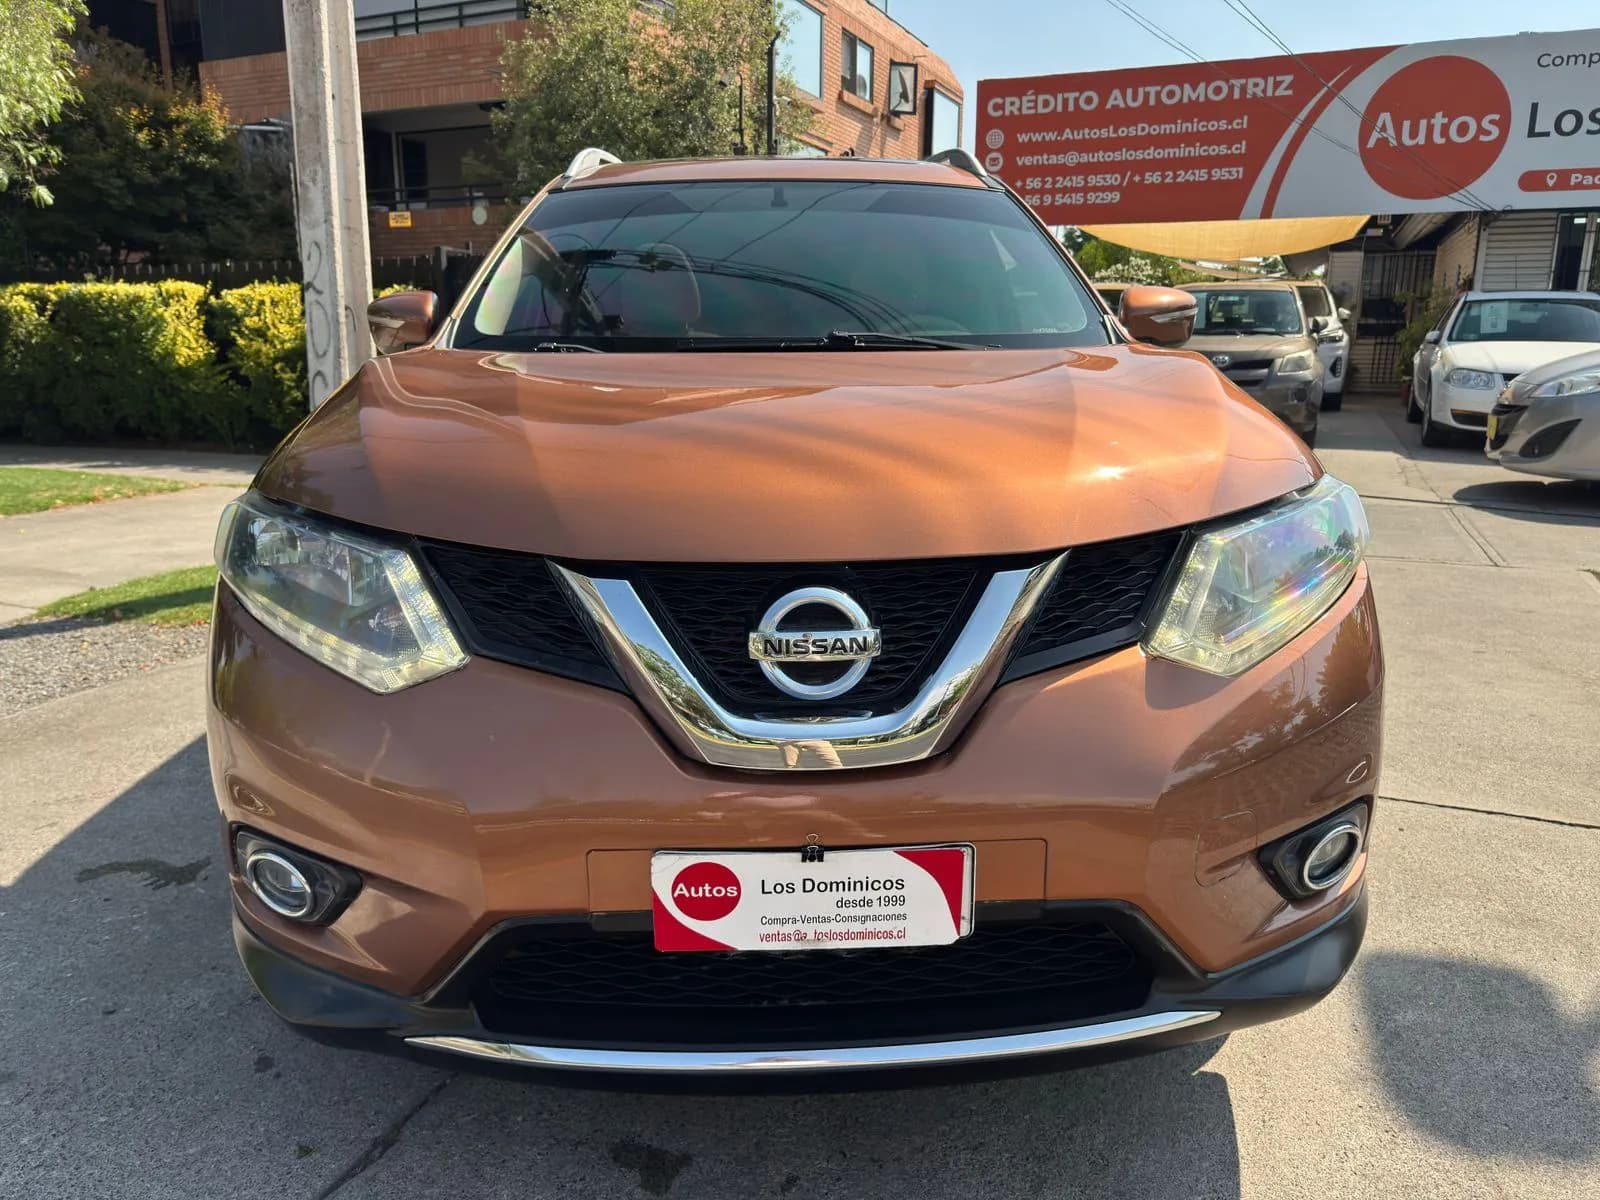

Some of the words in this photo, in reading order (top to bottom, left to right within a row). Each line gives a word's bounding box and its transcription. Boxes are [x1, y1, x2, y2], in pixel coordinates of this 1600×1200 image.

[987, 89, 1099, 117] CRÉDITO
[1105, 74, 1294, 109] AUTOMOTRIZ
[1016, 115, 1248, 143] www.AutosLosDominicos.cl
[1366, 111, 1501, 149] Autos
[1015, 140, 1246, 167] ventas@autoslosdominicos.cl
[1025, 177, 1042, 189] 56
[1044, 177, 1052, 188] 2
[1055, 175, 1085, 188] 2415
[1087, 173, 1121, 186] 9530
[1143, 171, 1162, 184] 56
[1163, 171, 1174, 183] 2
[1176, 169, 1208, 182] 2415
[1211, 167, 1244, 180] 9531
[1043, 194, 1052, 205] 9
[1054, 193, 1084, 205] 5415
[1087, 191, 1120, 204] 9299
[764, 636, 868, 656] NISSAN
[672, 882, 738, 898] Autos
[761, 879, 796, 895] Los
[802, 876, 905, 893] Dominicos
[836, 896, 873, 909] desde
[876, 894, 906, 908] 1999
[760, 912, 908, 927] Compra-Ventas-Consignaciones
[759, 927, 906, 943] ventas@atoslosdominicos.cl
